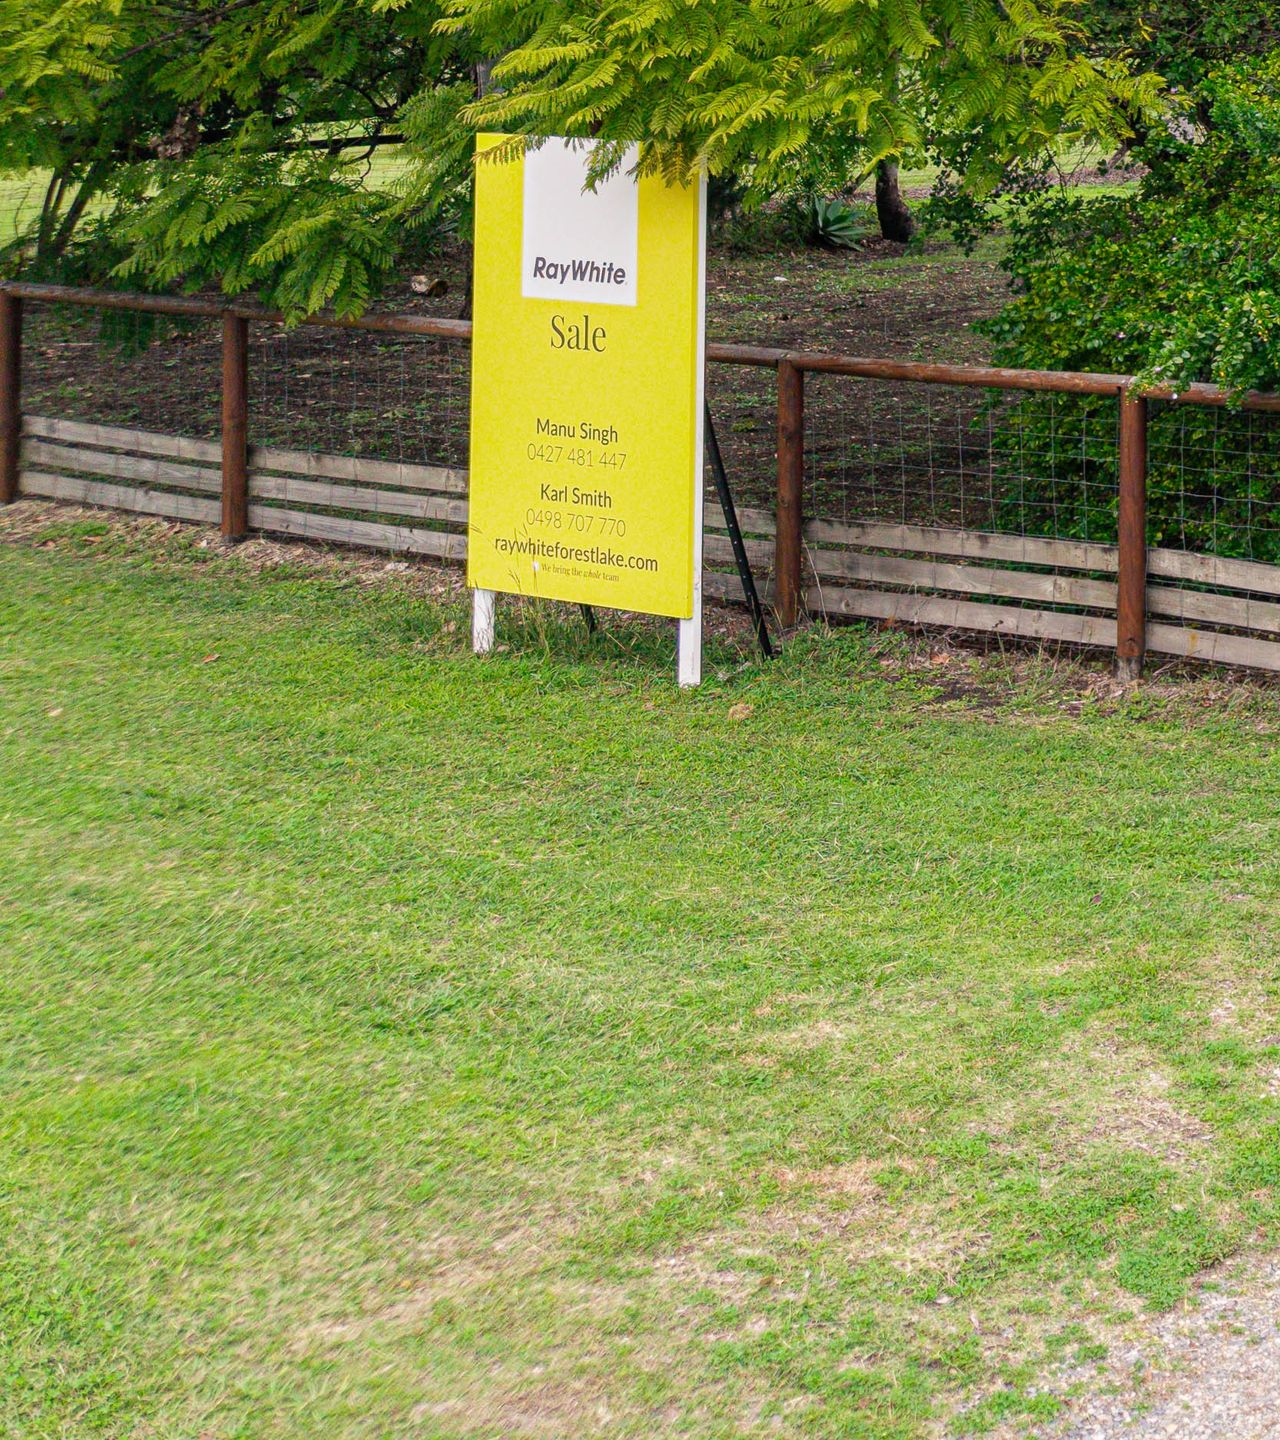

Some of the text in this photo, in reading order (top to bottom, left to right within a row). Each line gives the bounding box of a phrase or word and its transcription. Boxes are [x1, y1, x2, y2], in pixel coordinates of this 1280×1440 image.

[533, 257, 626, 285] RayWhite
[550, 315, 606, 352] Sale
[536, 418, 618, 445] Manu Singh
[527, 443, 627, 470] 0427 481 447
[540, 483, 612, 508] Karl Smith
[526, 508, 626, 537] 0498 707 770
[494, 537, 659, 572] raywhiteforestlake.com
[572, 567, 582, 576] the
[603, 572, 620, 582] team
